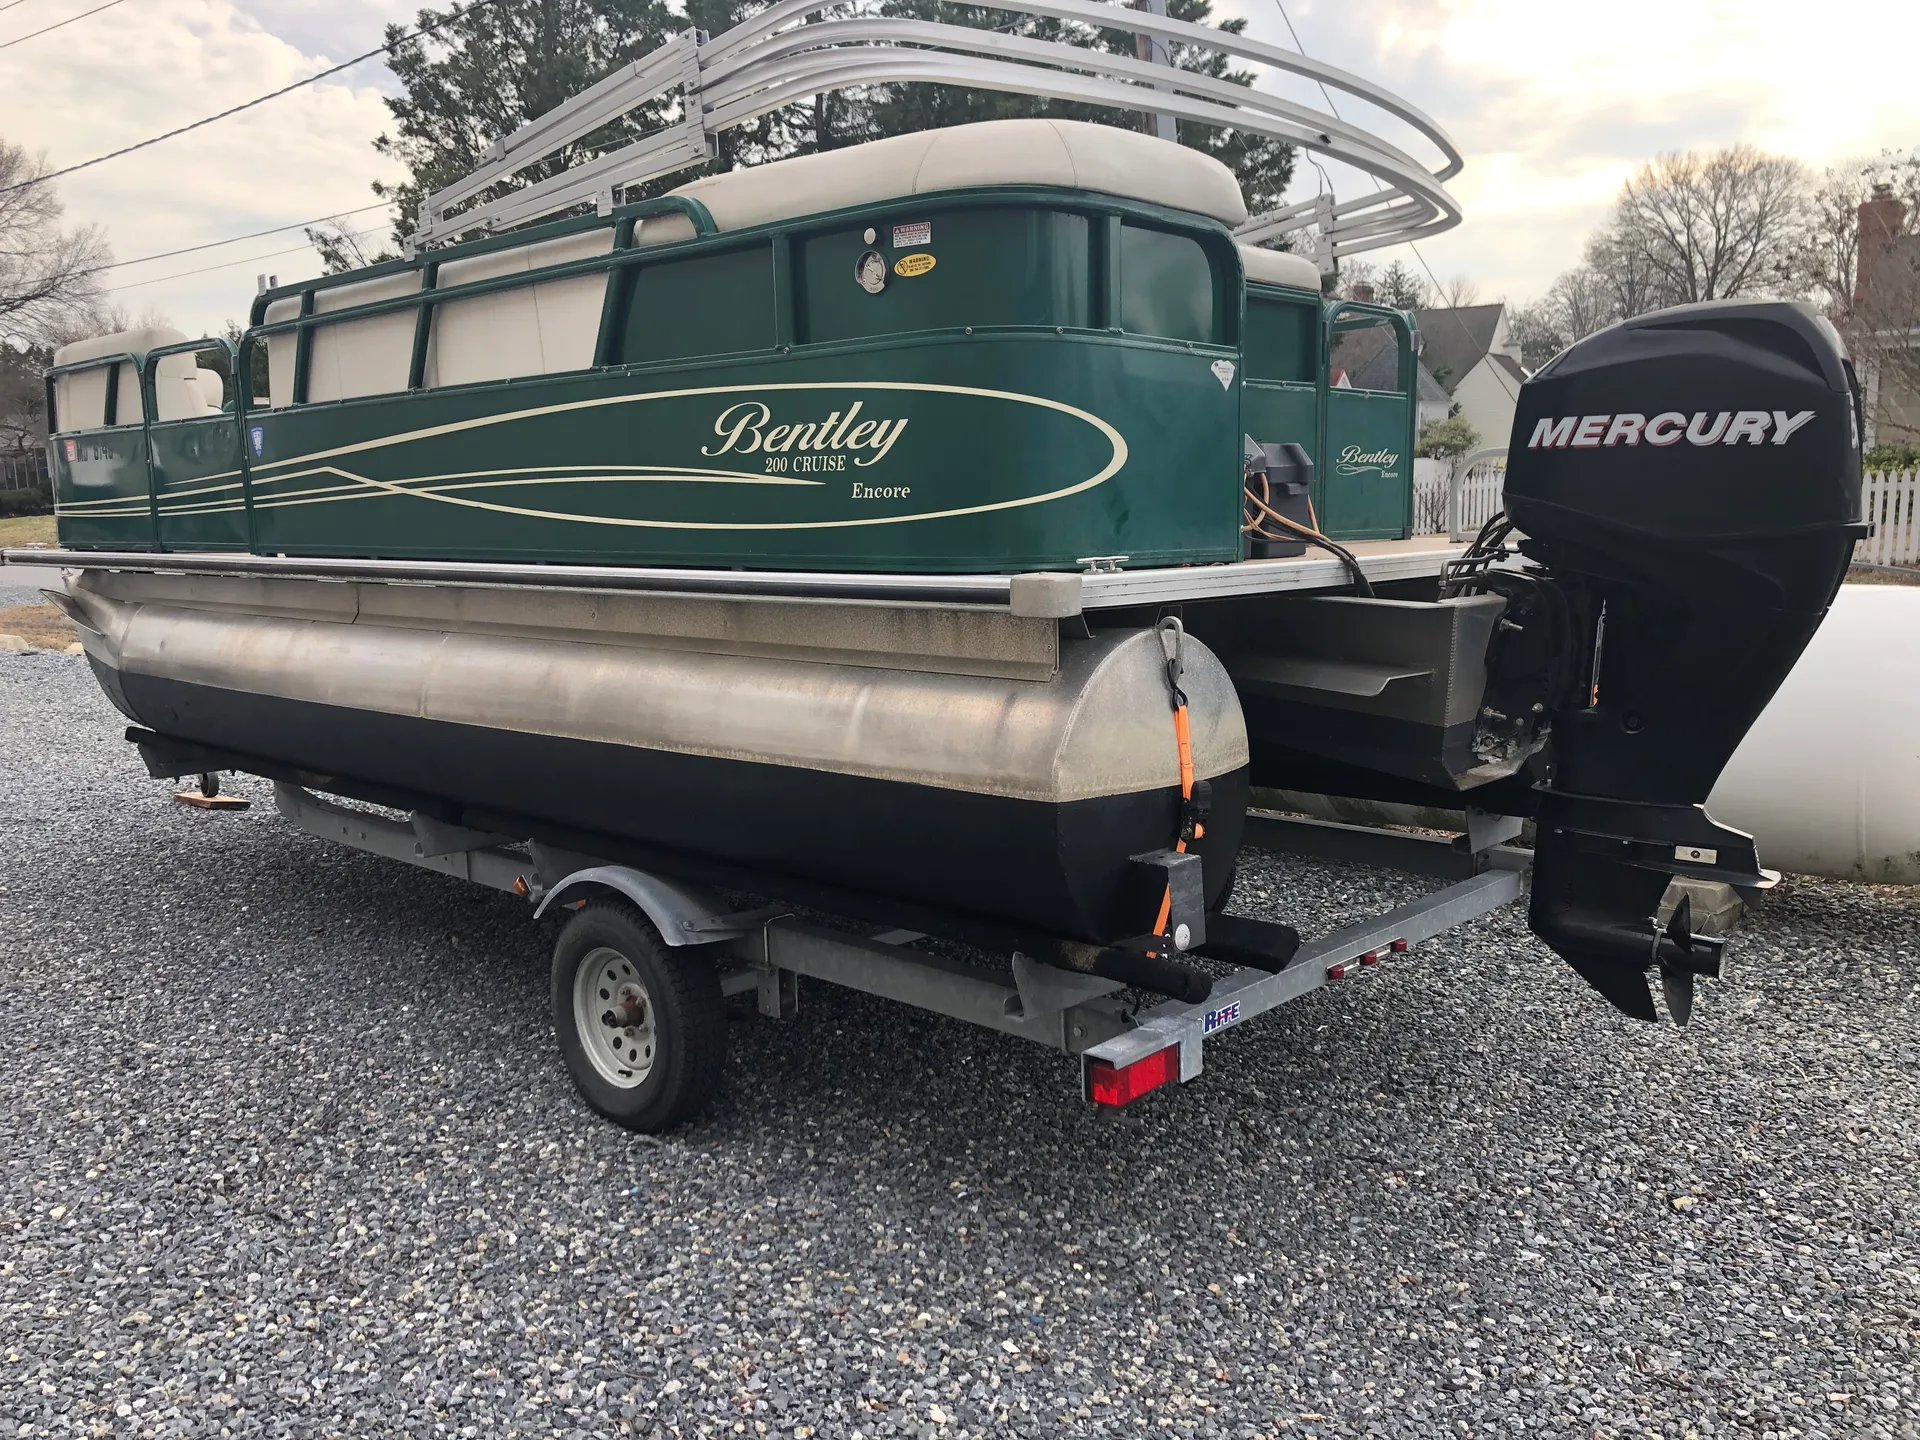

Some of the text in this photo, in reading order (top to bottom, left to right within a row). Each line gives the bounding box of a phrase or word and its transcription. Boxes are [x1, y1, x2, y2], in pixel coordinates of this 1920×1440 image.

[900, 223, 929, 234] WARNING
[908, 256, 930, 264] WARNING
[701, 401, 909, 467] Bentley
[1528, 410, 1817, 450] MERCURY
[765, 455, 847, 473] 200 CRUISE
[1336, 444, 1399, 469] Bentley
[851, 482, 911, 499] Encore
[1204, 1000, 1240, 1035] RITE
